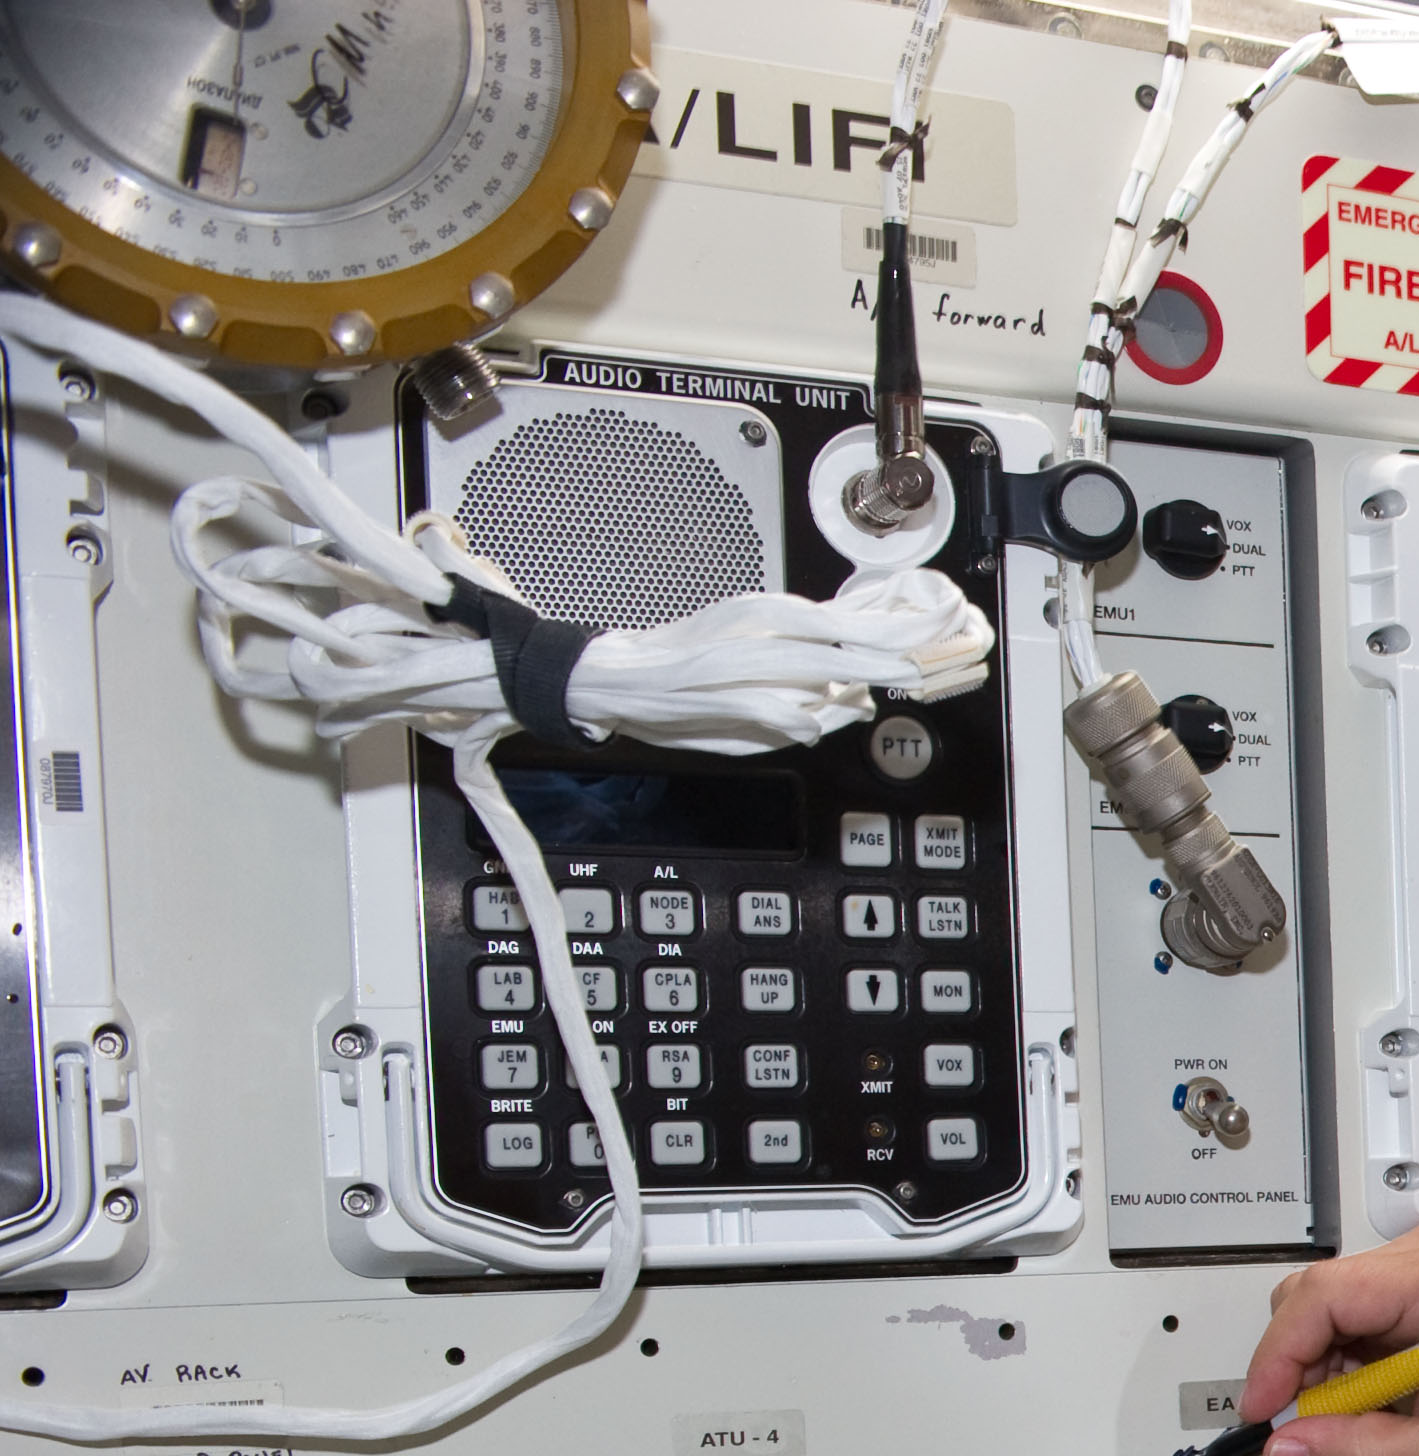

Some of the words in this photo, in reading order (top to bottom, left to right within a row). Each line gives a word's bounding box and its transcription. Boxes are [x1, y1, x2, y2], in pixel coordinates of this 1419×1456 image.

[932, 293, 1045, 336] forward
[564, 362, 642, 389] AUDIO
[656, 372, 781, 404] TERMINAL
[796, 387, 850, 410] UNIT
[1226, 520, 1251, 532] VOX
[1233, 543, 1266, 556] DUAL
[1232, 565, 1255, 576] PTT
[1093, 605, 1136, 621] EMU1
[1232, 711, 1257, 722] VOX
[1238, 733, 1271, 746] DUAL
[1238, 755, 1261, 767] PTT
[1174, 1059, 1205, 1070] PWR
[1208, 1059, 1227, 1070] ON
[1191, 1148, 1217, 1160] OFF
[1111, 1194, 1140, 1206] EMU
[1144, 1193, 1186, 1205] AUDIO
[1190, 1192, 1253, 1204] CONTROL
[1257, 1191, 1298, 1202] PANEL
[176, 1364, 241, 1383] RACK
[700, 1431, 745, 1447] ATU
[767, 1429, 779, 1443] 4
